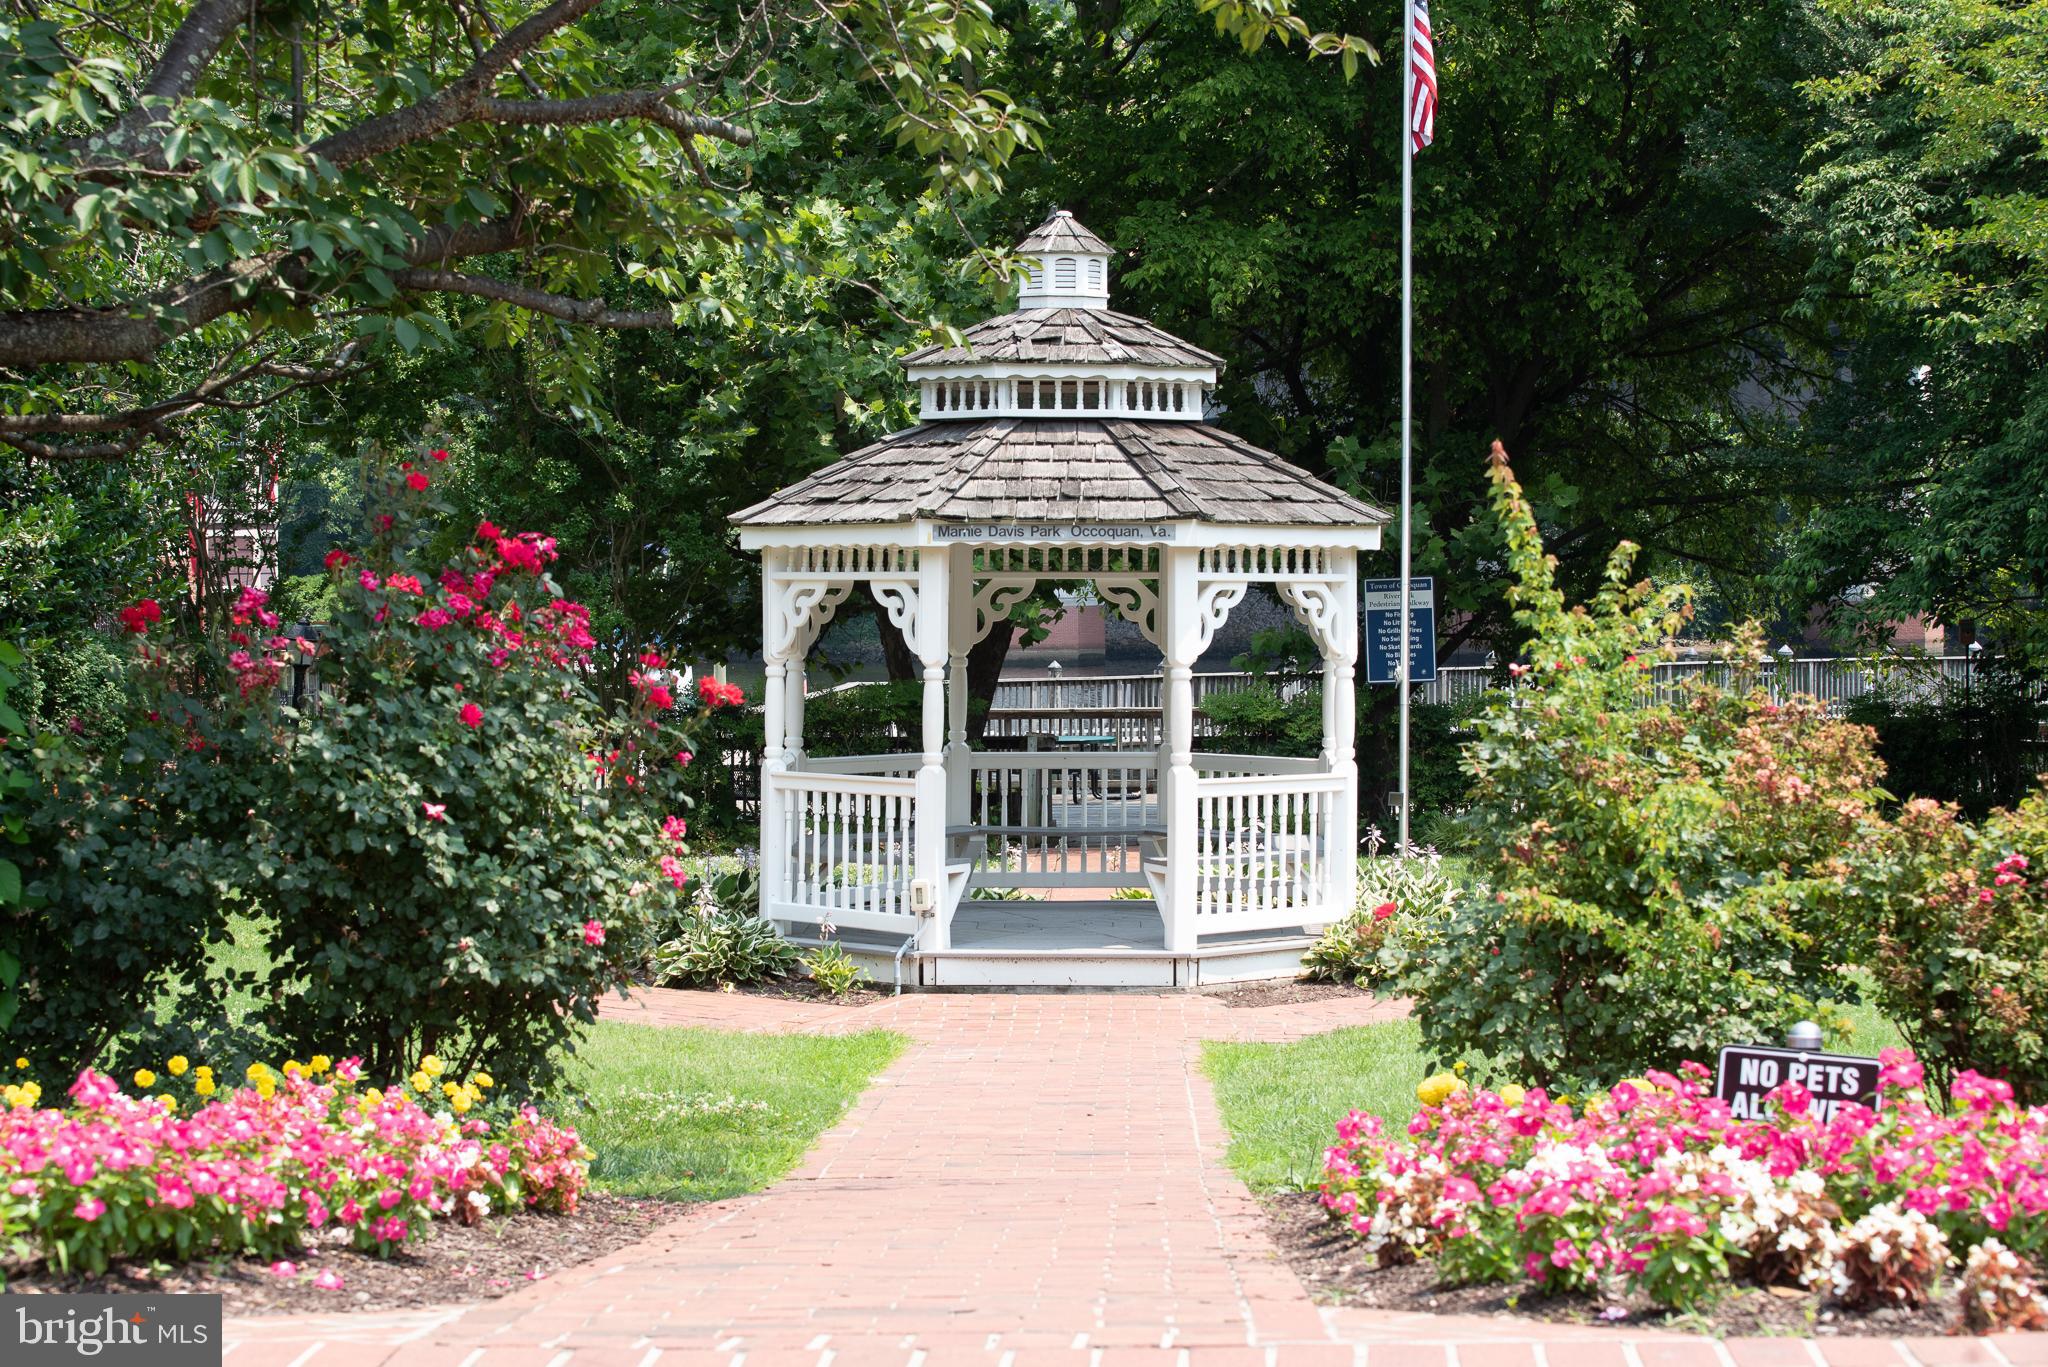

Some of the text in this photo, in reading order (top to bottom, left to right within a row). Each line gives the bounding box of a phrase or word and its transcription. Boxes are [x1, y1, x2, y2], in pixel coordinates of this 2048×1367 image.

[988, 525, 1025, 538] Davis
[1030, 525, 1061, 538] Park
[1070, 525, 1144, 540] Occoquan,
[1370, 582, 1388, 590] Town
[1369, 600, 1430, 608] Pedestrian alkway
[1739, 1057, 1861, 1096] NO PETS
